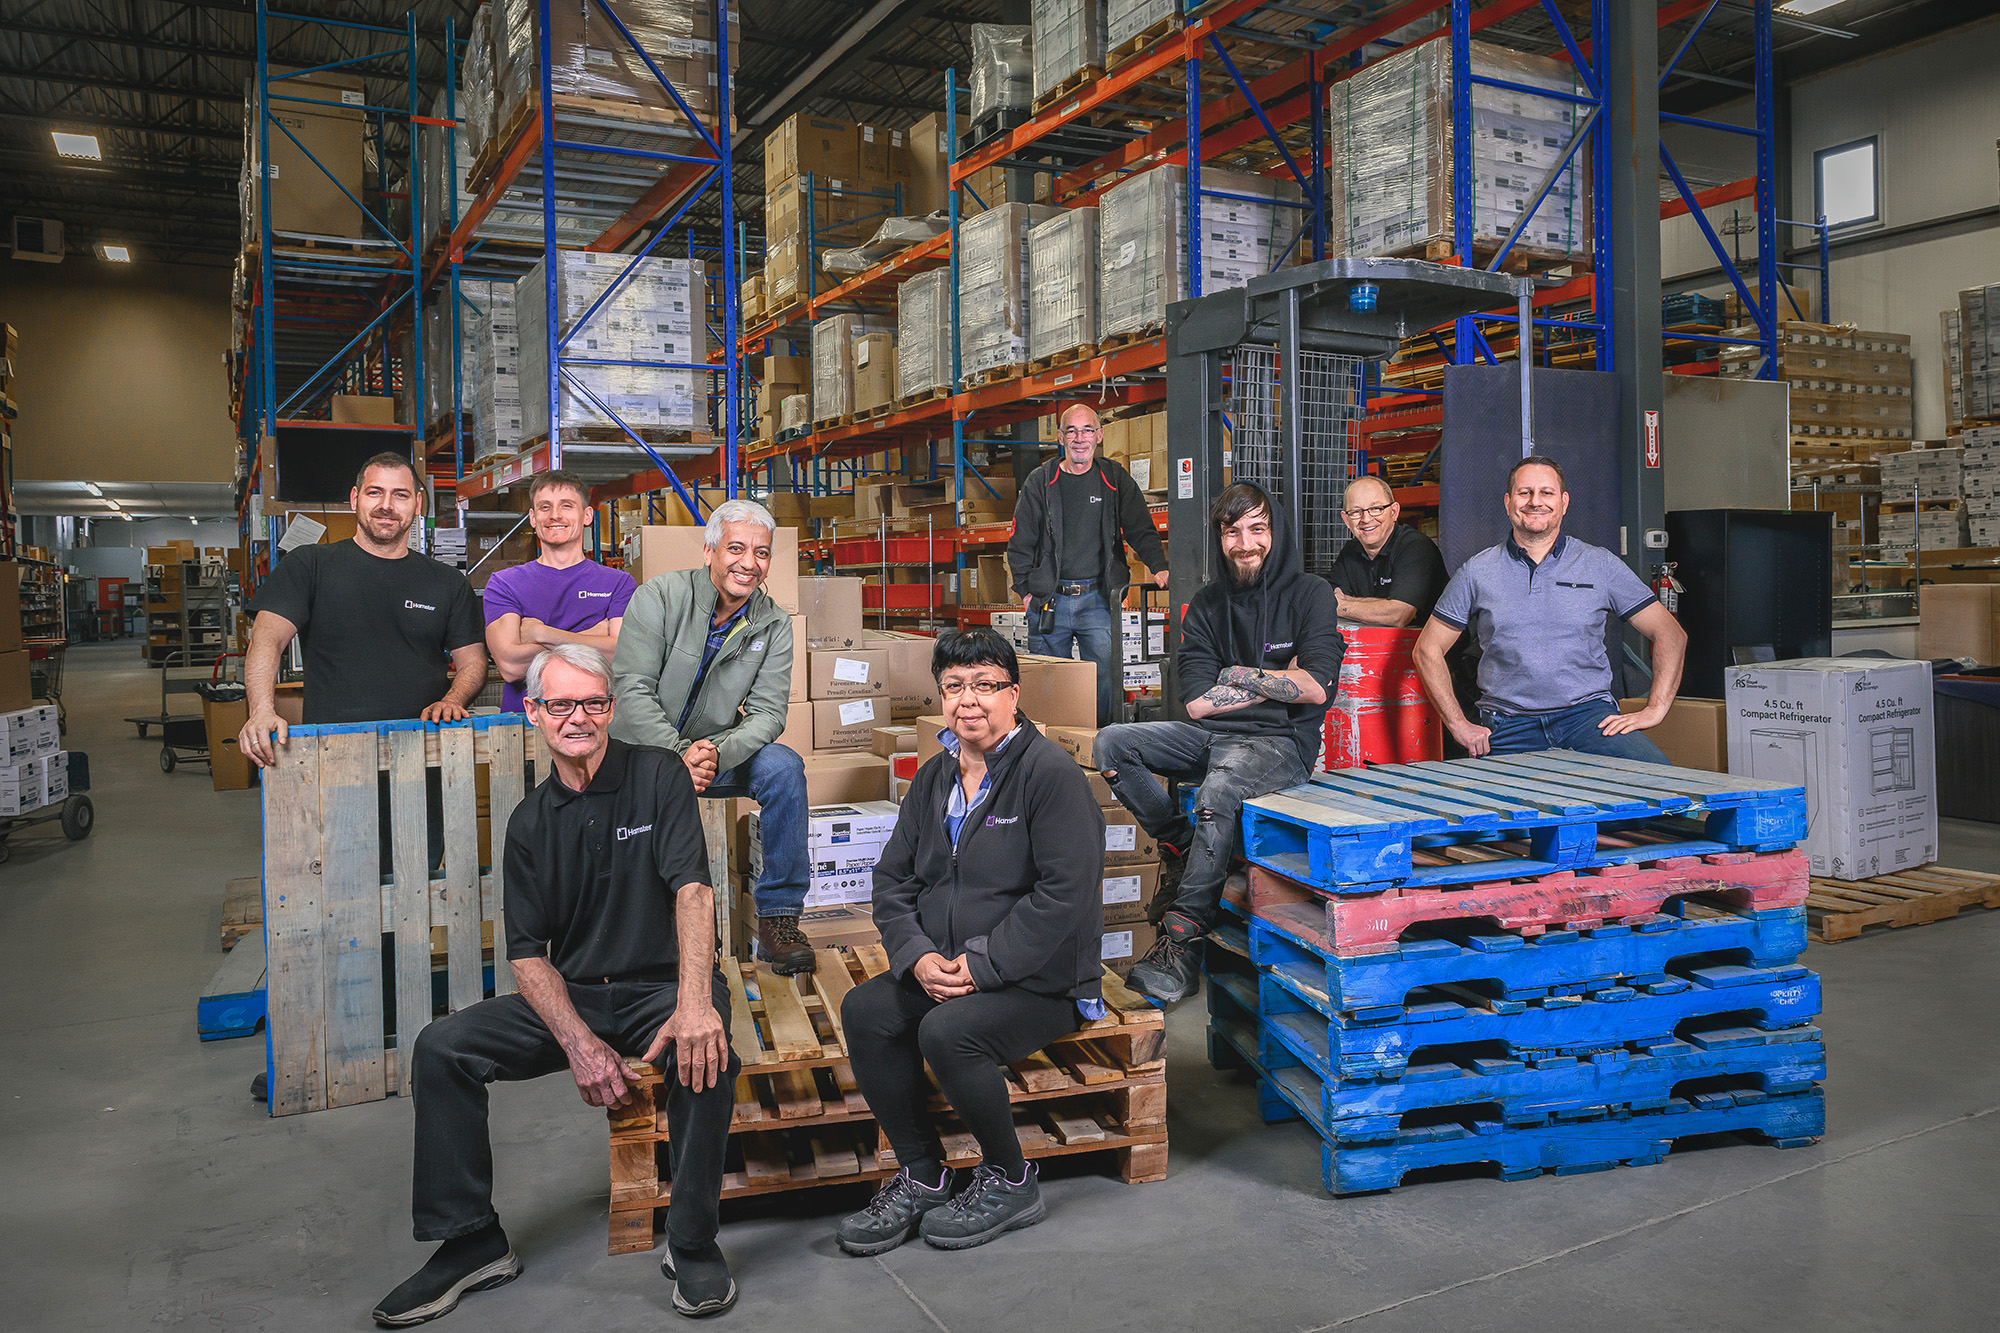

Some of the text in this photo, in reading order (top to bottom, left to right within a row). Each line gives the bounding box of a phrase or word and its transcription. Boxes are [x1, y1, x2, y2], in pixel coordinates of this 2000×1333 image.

[149, 565, 164, 578] 14
[204, 565, 216, 578] 17
[1764, 700, 1804, 710] 4.5 Cu. ft
[1876, 700, 1885, 708] 4.5
[1741, 709, 1832, 724] Compact Refrigerator
[1859, 707, 1921, 723] Compact Refrigerator
